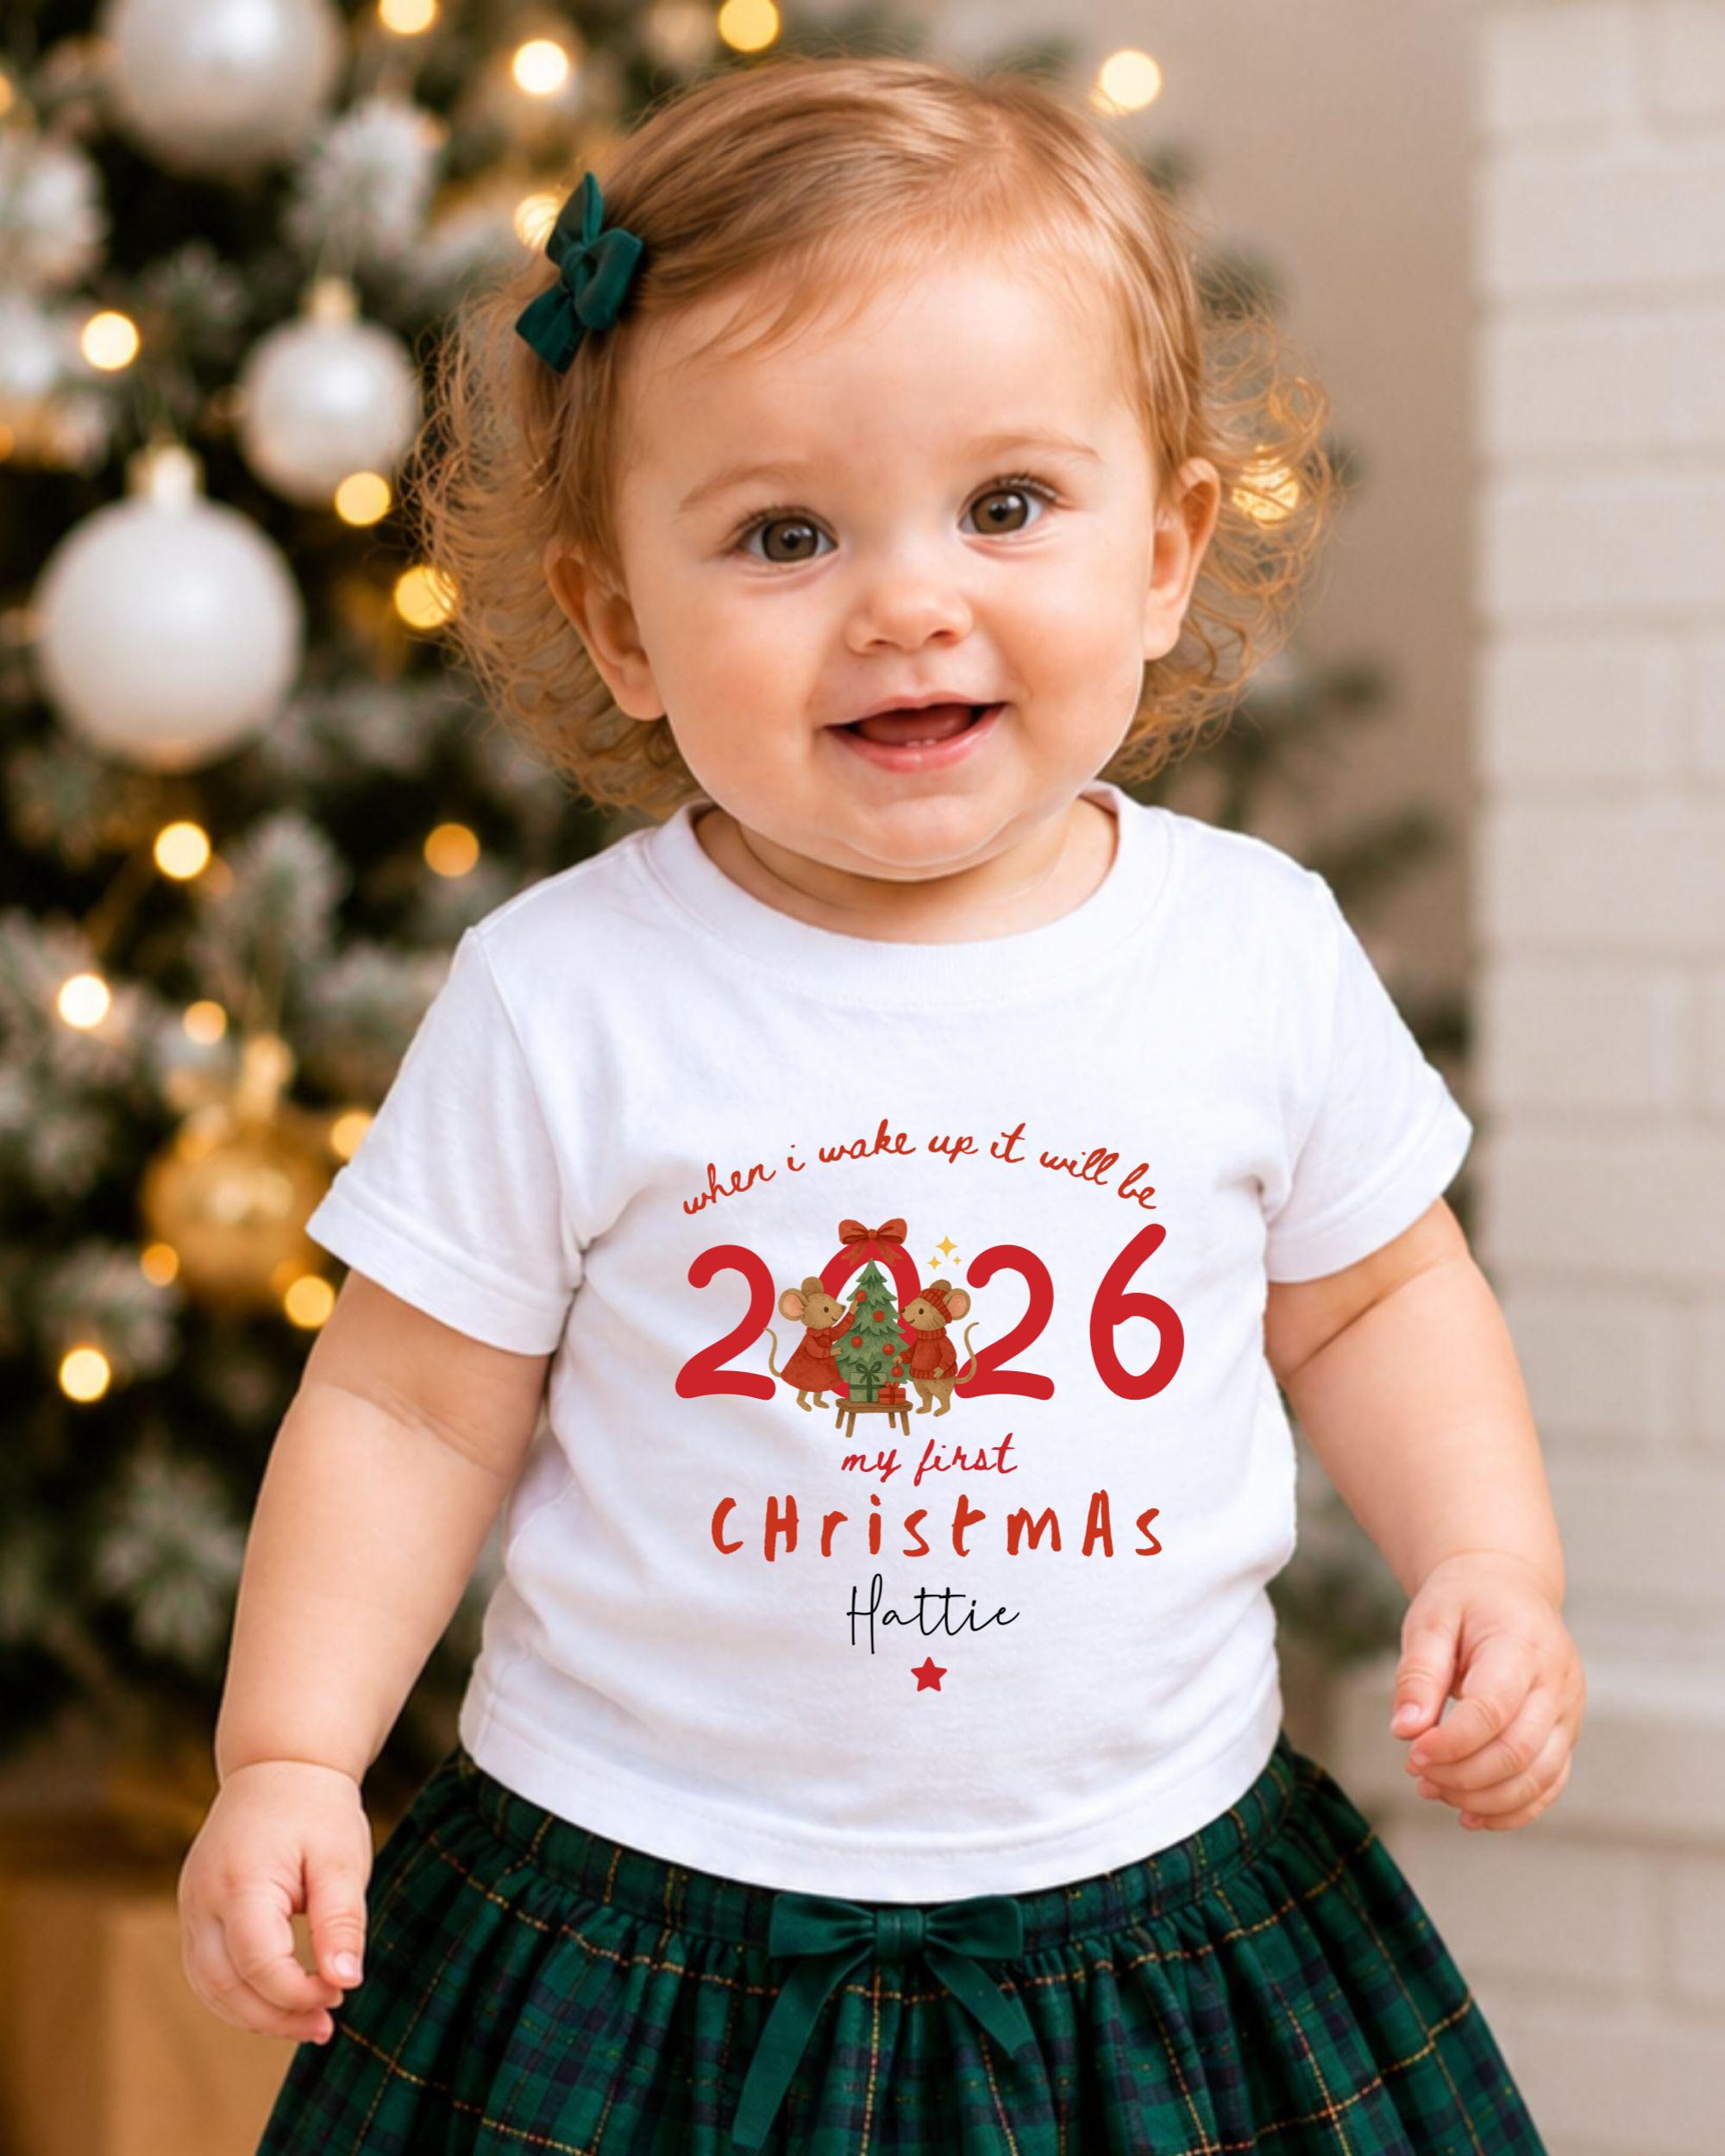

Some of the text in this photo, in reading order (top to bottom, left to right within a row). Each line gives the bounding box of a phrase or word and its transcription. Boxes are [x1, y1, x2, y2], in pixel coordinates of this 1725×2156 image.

[682, 1119, 1157, 1215] when i wake up it will be
[841, 1432, 1019, 1488] my first
[845, 1573, 1020, 1655] Hattie
